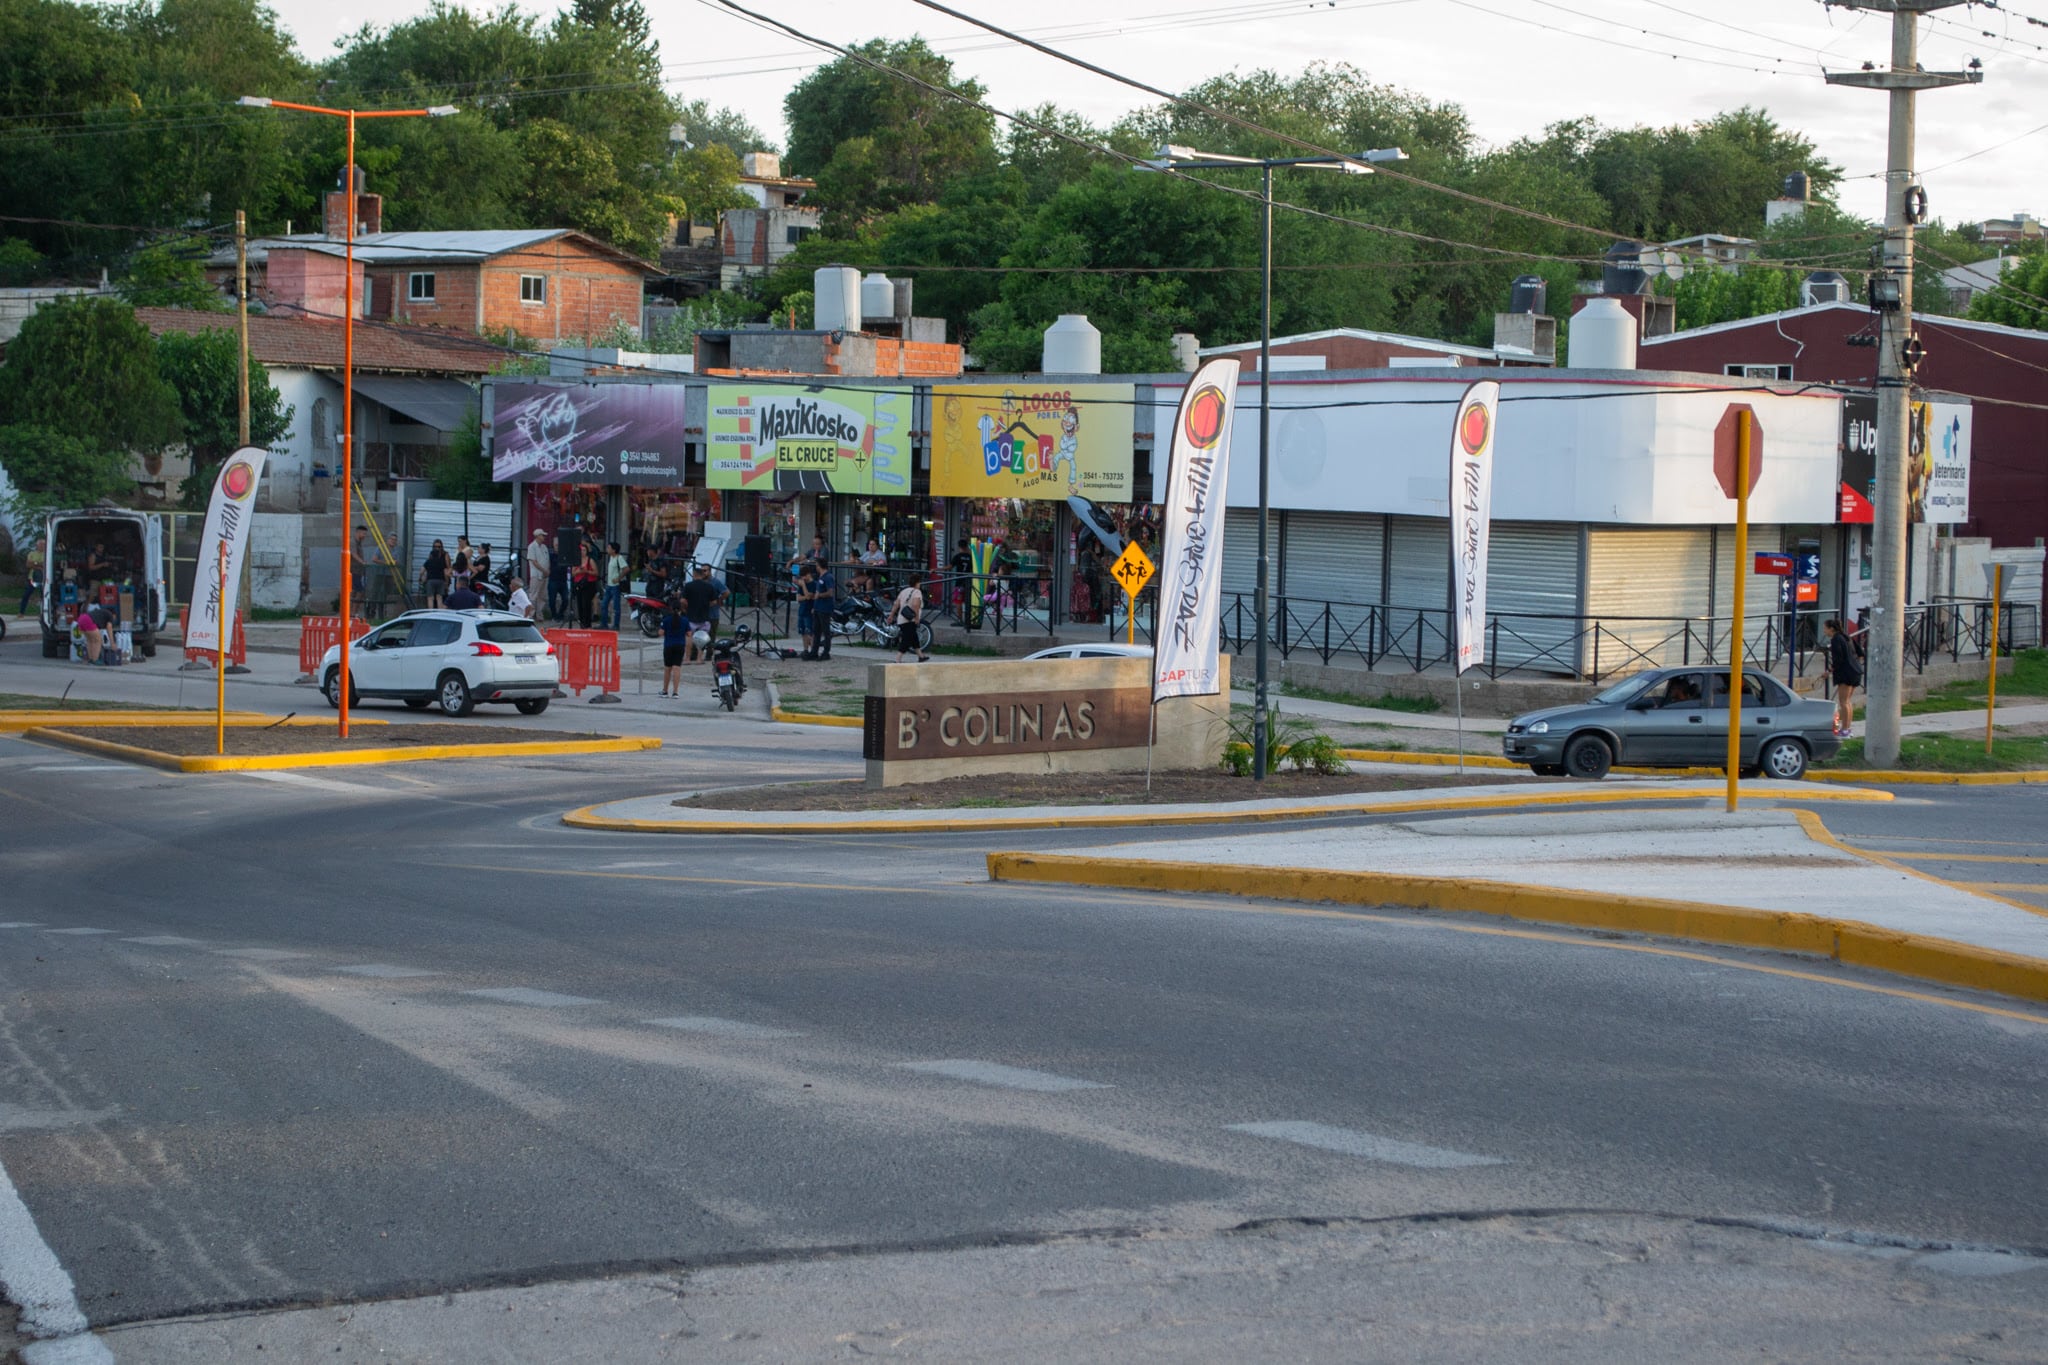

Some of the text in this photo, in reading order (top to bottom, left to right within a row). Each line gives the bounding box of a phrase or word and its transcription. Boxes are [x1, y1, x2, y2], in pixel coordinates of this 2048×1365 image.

[1022, 390, 1072, 411] LOCOS
[1037, 411, 1061, 419] POR EL
[759, 397, 858, 446] MaxiKiosko
[779, 446, 835, 463] EL CRUCE
[986, 441, 1049, 473] bazar
[1935, 462, 1965, 479] Veterinaria
[1023, 477, 1040, 488] ALGO
[1185, 456, 1213, 518] VILLA
[1463, 461, 1481, 512] VILLA
[218, 502, 241, 541] VILLA
[1174, 586, 1199, 654] PAZ
[939, 700, 1096, 748] COLINAS
